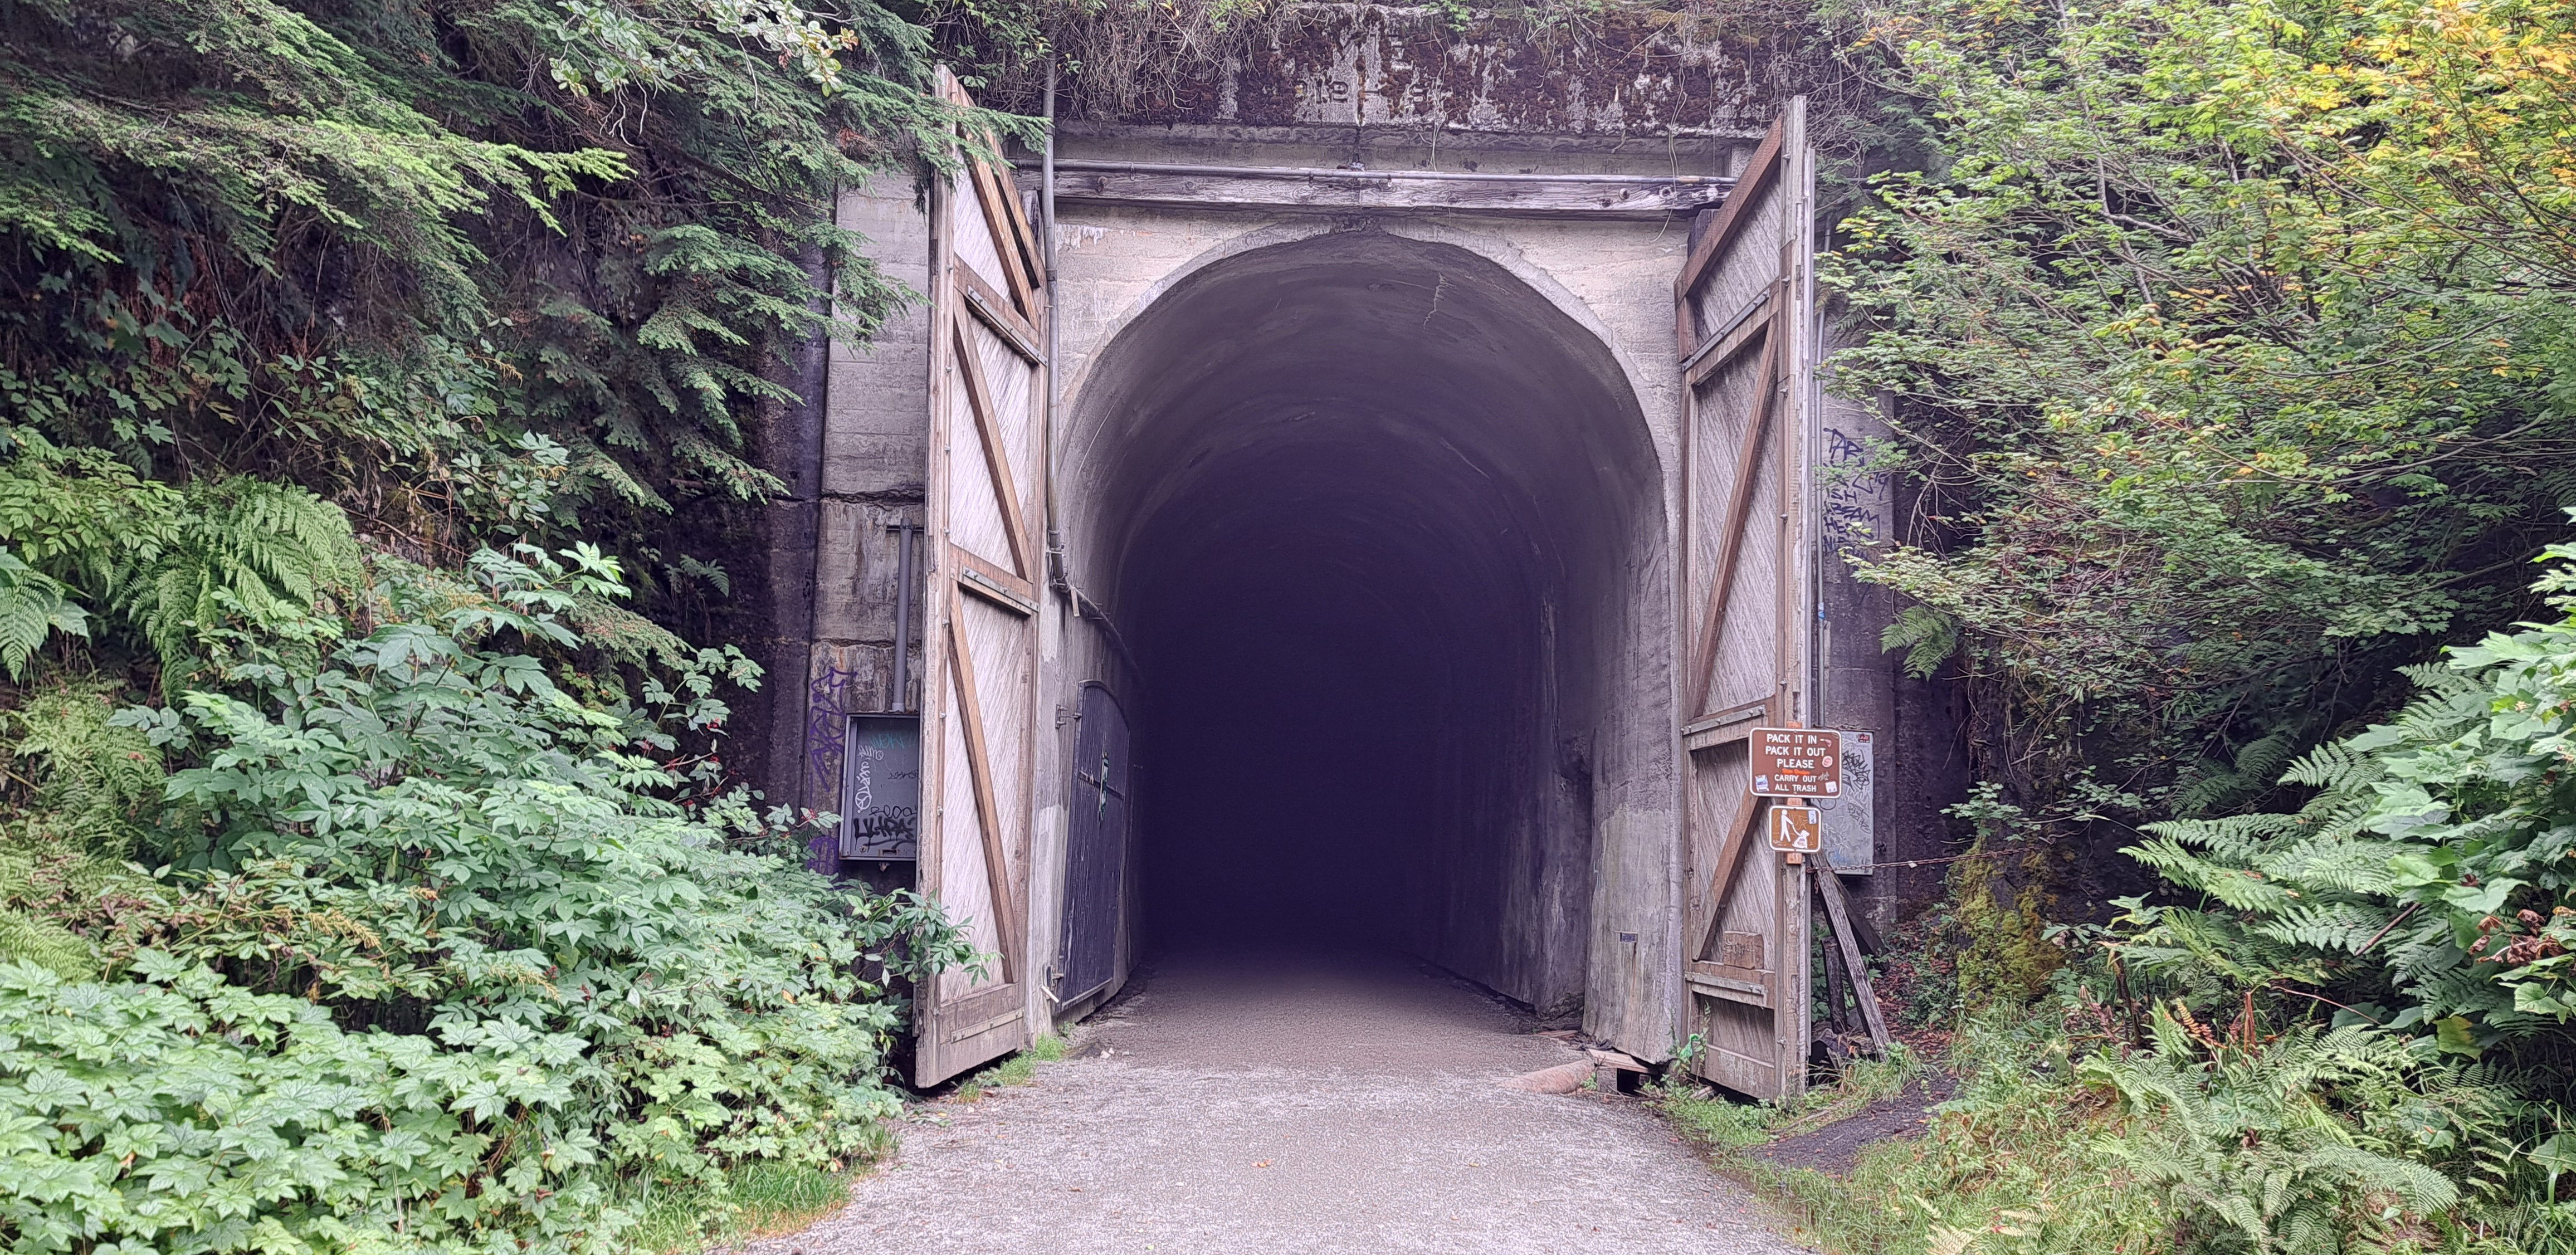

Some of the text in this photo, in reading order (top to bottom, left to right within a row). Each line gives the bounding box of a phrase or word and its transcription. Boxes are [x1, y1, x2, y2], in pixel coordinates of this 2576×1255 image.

[1767, 733, 1817, 744] PACK IT IN
[1765, 745, 1826, 756] PACK IT OUT
[1777, 758, 1814, 769] PLEASE
[1774, 774, 1799, 782] CARRY
[1774, 783, 1789, 792] ALL
[1792, 784, 1817, 792] TRASH
